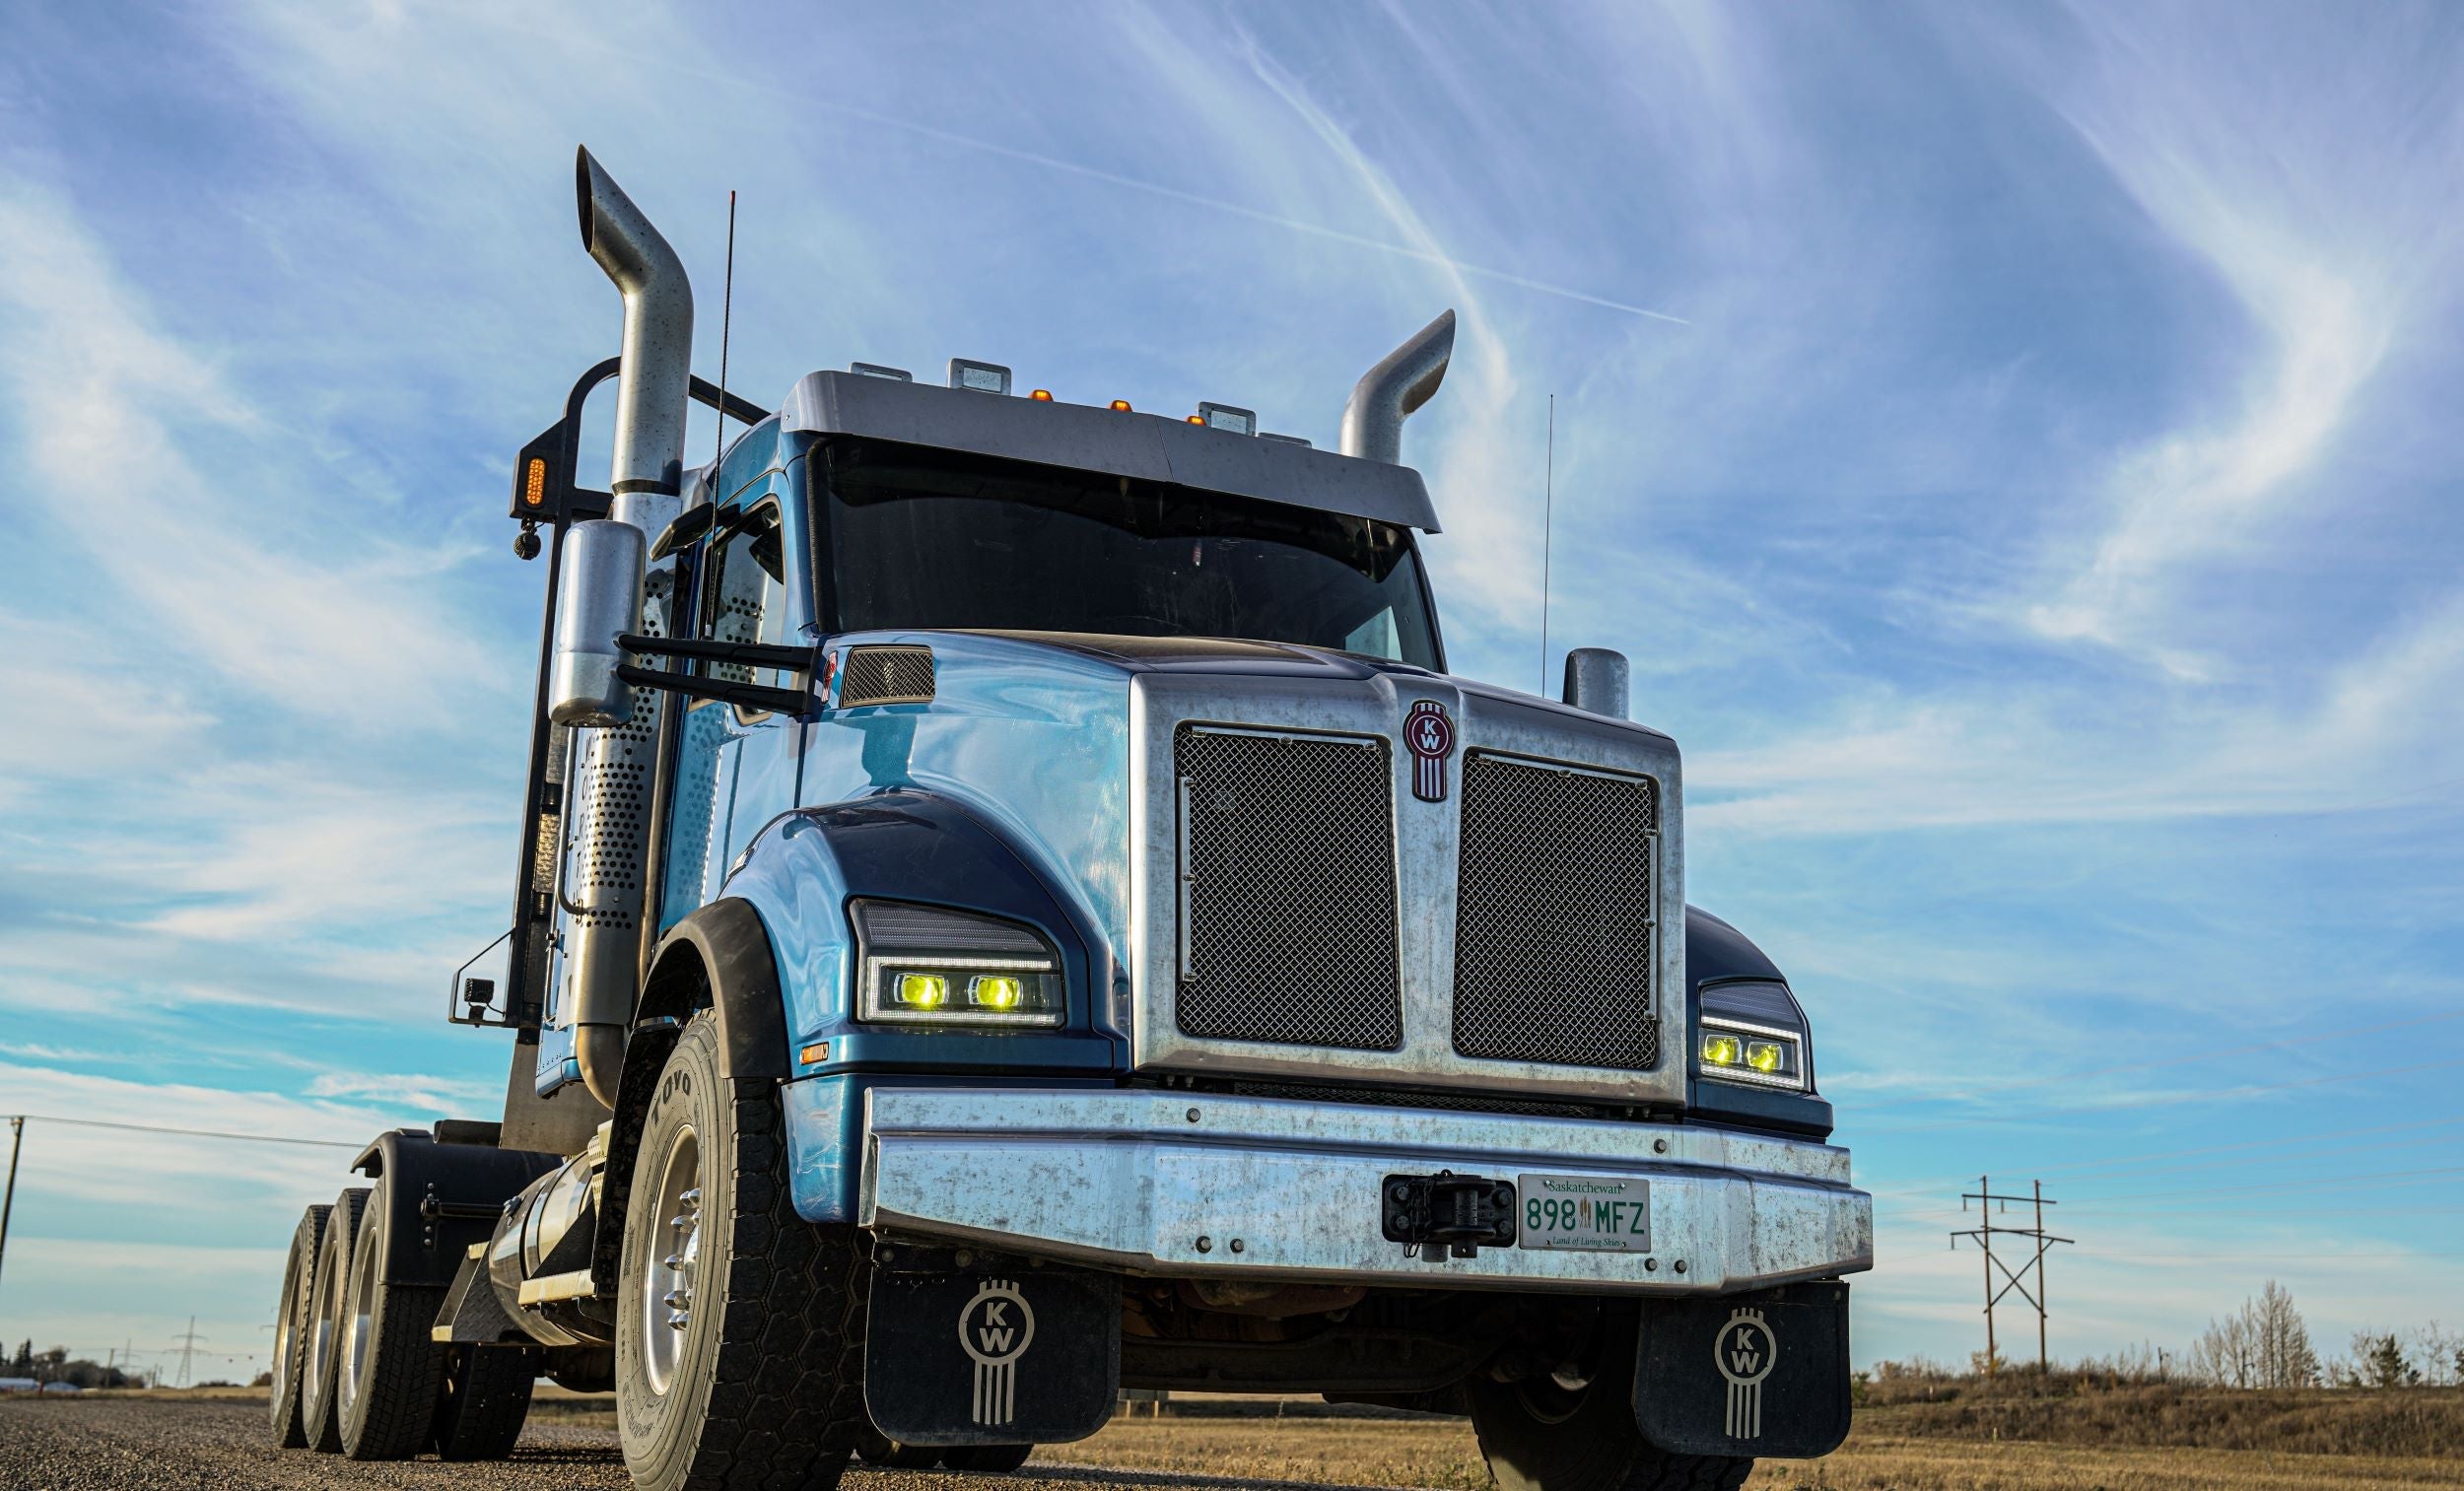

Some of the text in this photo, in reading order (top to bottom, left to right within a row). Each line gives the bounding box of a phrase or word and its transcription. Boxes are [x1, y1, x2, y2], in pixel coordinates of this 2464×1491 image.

[651, 1070, 691, 1126] TOYO
[1548, 1180, 1621, 1194] Saskatchewan
[1528, 1197, 1644, 1234] 898 MFZ
[1552, 1236, 1620, 1248] Land of Living Skies
